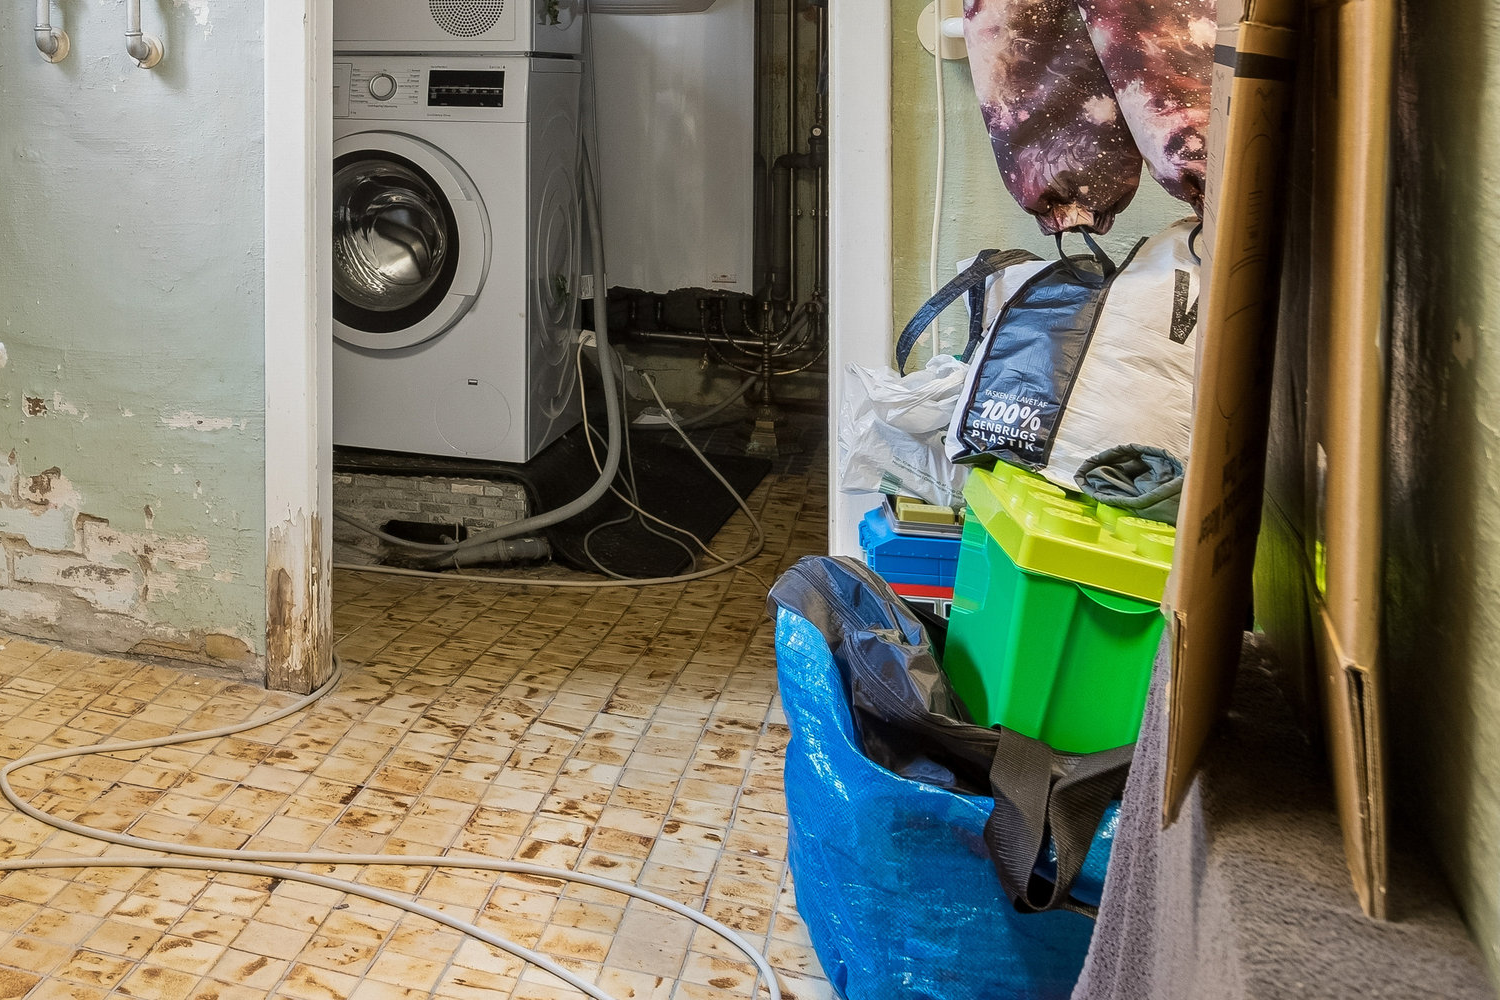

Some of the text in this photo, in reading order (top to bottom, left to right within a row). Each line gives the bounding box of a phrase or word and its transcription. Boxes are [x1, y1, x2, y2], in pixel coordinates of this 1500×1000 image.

[985, 389, 1009, 401] TASKEN
[1017, 396, 1037, 406] LAVET
[980, 399, 1041, 432] 100%
[970, 429, 1035, 452] PLASTIK
[972, 419, 1037, 442] GENBRUGS
